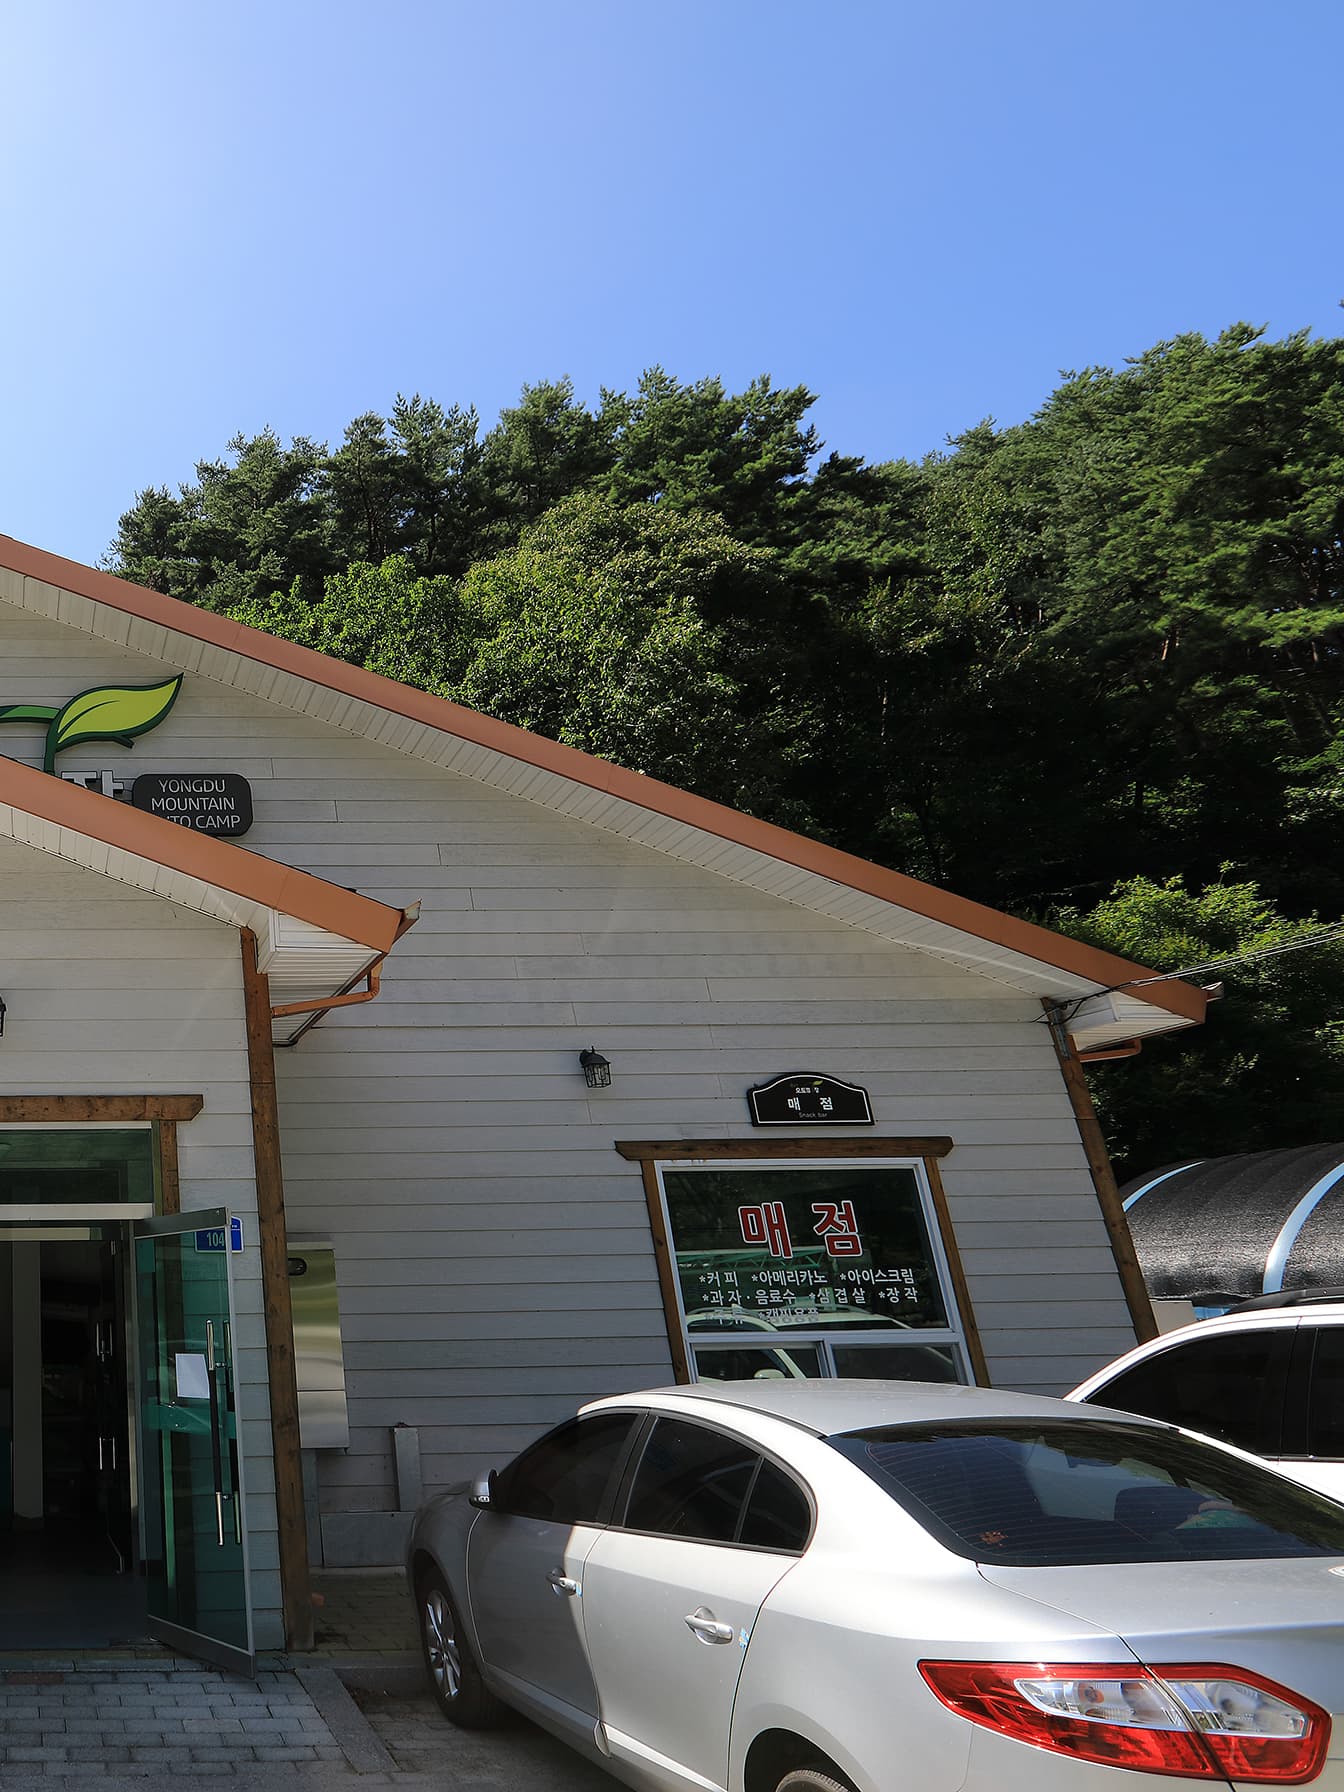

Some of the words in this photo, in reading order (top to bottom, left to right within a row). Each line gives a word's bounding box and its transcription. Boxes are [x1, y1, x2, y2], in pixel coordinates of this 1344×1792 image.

[158, 779, 226, 793] YONGDU
[151, 797, 235, 811] MOUNTAIN
[195, 815, 241, 829] CAMP
[759, 1270, 828, 1286] 아메리카노
[847, 1269, 915, 1285] 아이스크림
